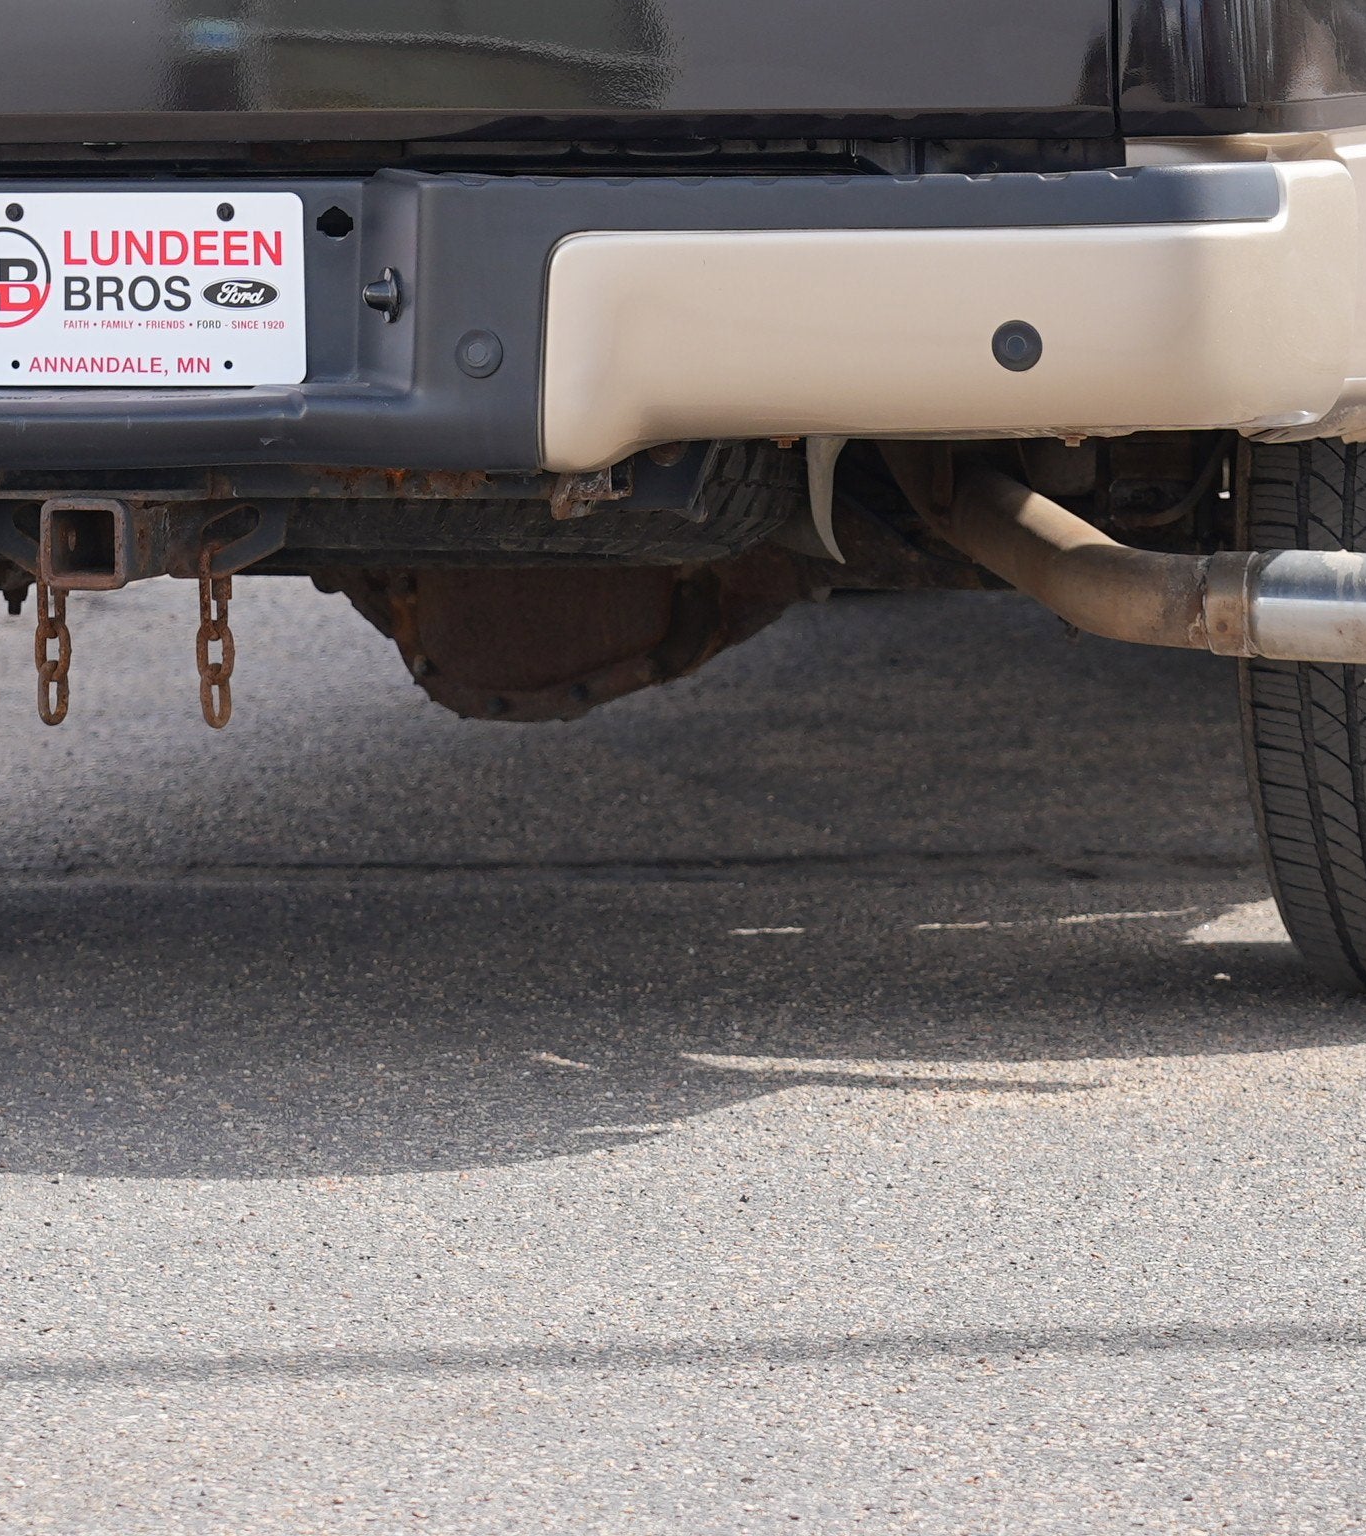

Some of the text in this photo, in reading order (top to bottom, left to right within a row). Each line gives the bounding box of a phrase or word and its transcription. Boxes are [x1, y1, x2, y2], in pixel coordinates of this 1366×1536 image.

[63, 230, 282, 266] LUNDEEN
[63, 275, 264, 312] BROS Ford
[63, 319, 90, 329] FAITH
[101, 319, 134, 330] FAMILY
[145, 319, 185, 330] FRIENDS
[197, 319, 221, 329] FORD
[231, 319, 259, 330] SINCE
[262, 319, 285, 330] 1920
[28, 356, 211, 376] ANNANDALE, MN
